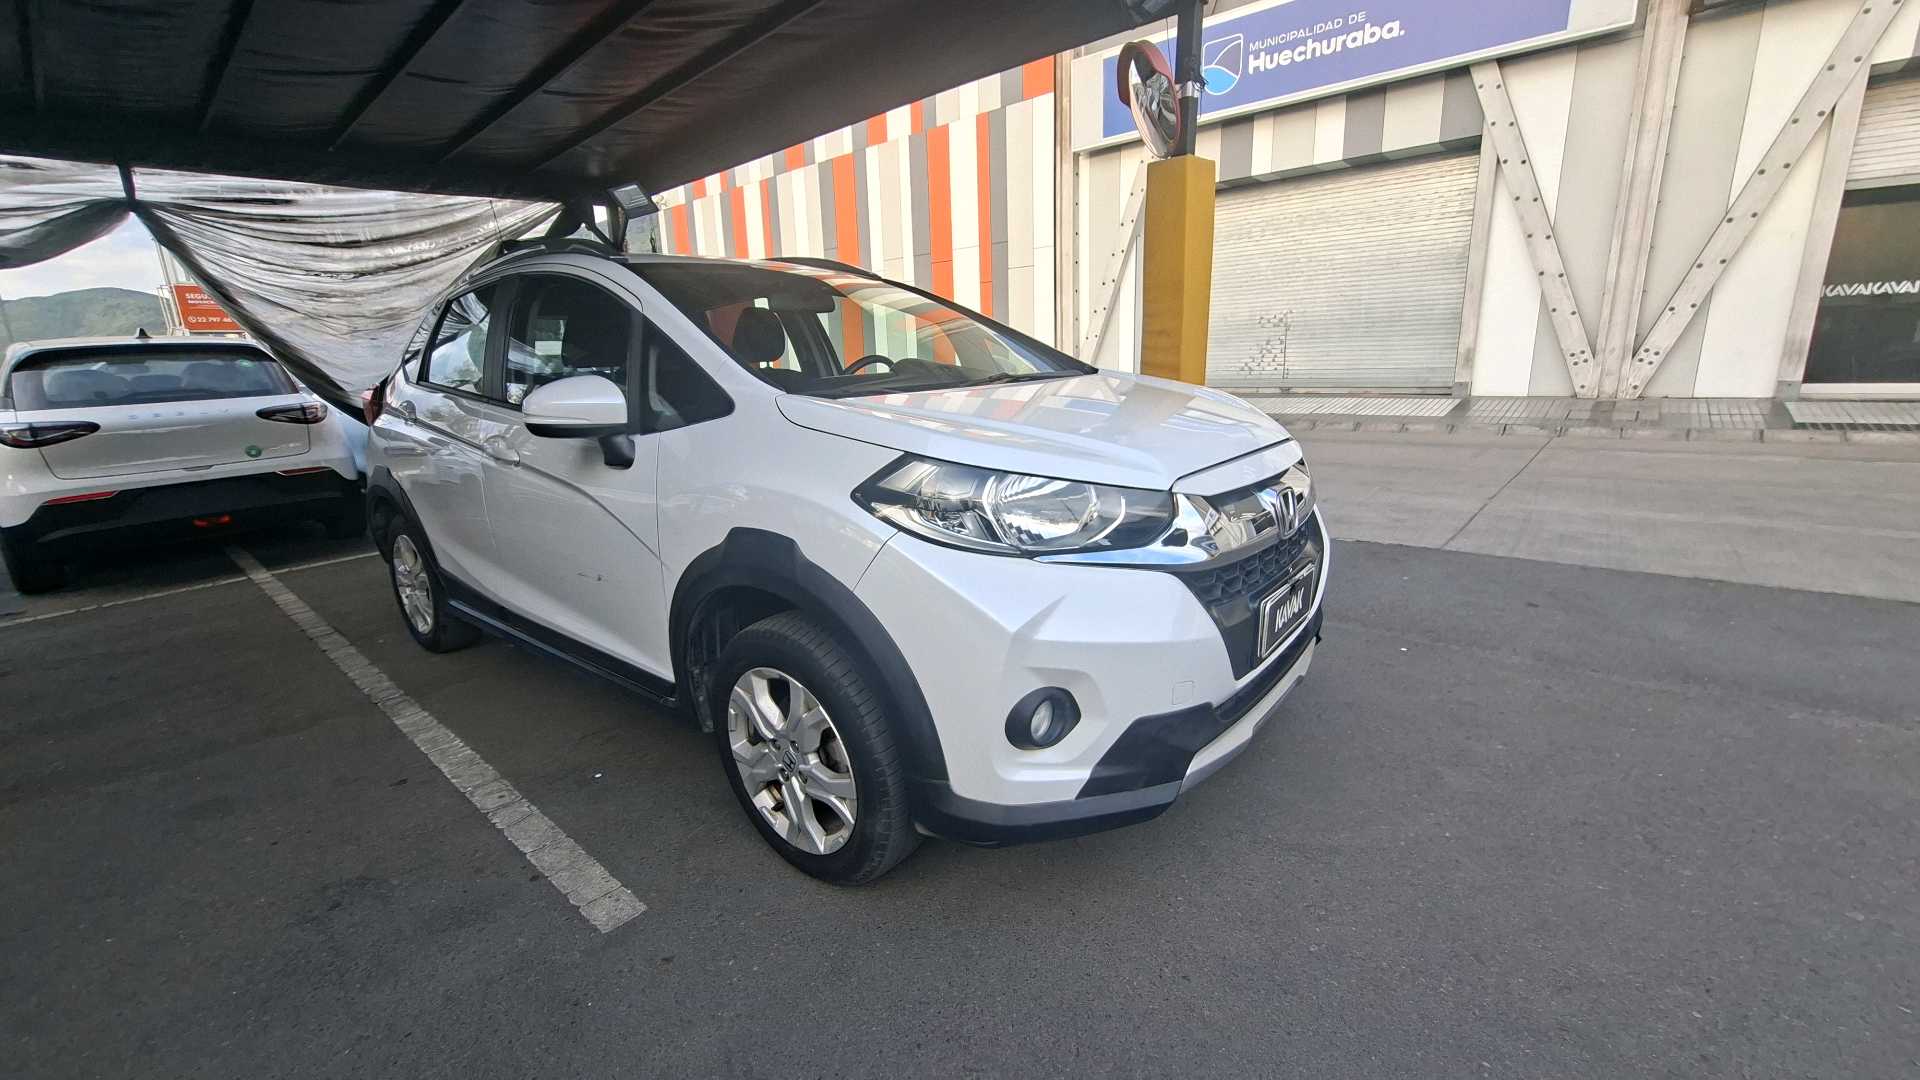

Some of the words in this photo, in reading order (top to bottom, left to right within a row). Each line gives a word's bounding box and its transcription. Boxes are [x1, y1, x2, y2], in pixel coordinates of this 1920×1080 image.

[1248, 20, 1405, 75] Huechuraba.
[1249, 18, 1343, 52] MUNICIPALIDAD
[1348, 11, 1367, 25] DE
[1274, 586, 1305, 633] KAVAK
